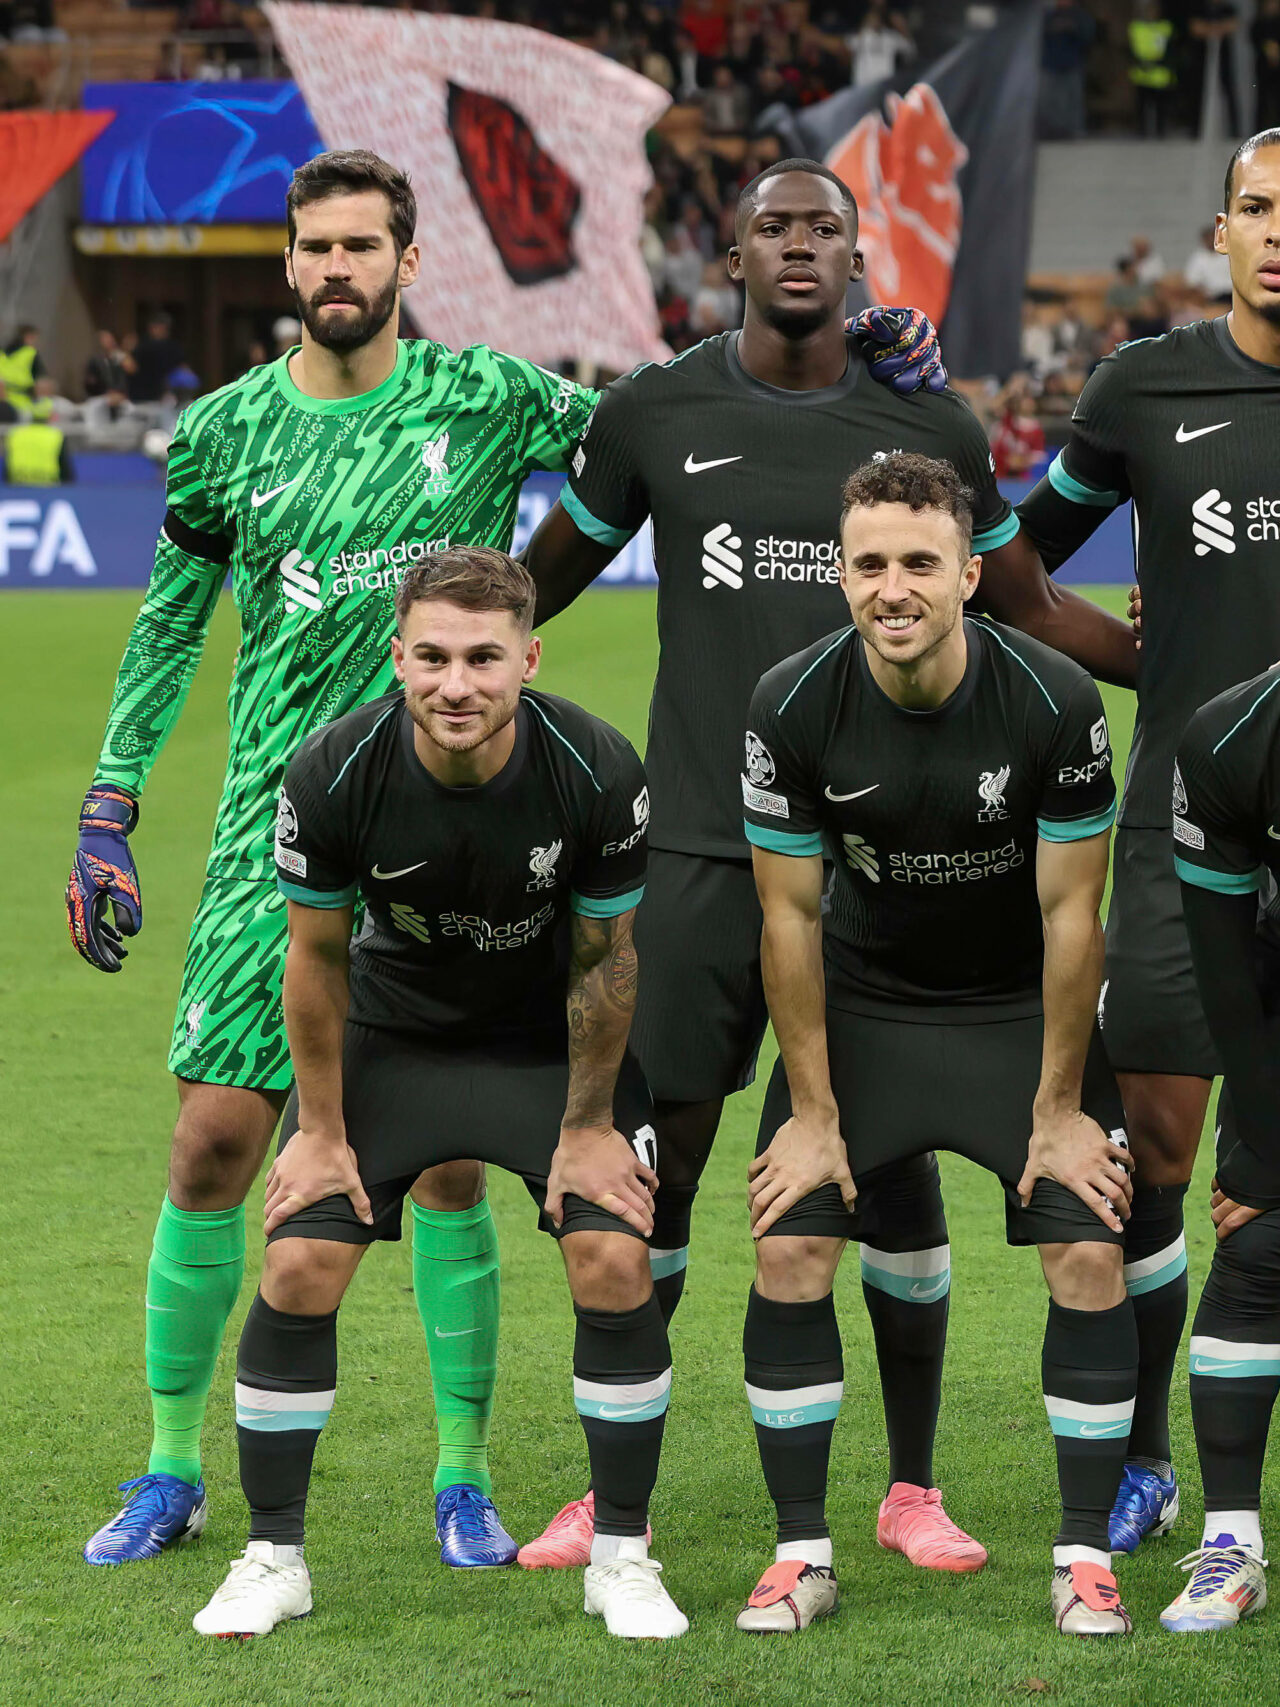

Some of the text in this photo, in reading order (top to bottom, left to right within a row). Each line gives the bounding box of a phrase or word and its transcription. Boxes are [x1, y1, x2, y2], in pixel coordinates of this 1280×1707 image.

[754, 558, 841, 585] charte
[889, 838, 1016, 869] standard
[891, 849, 1025, 884] chartered
[439, 901, 553, 938] standard
